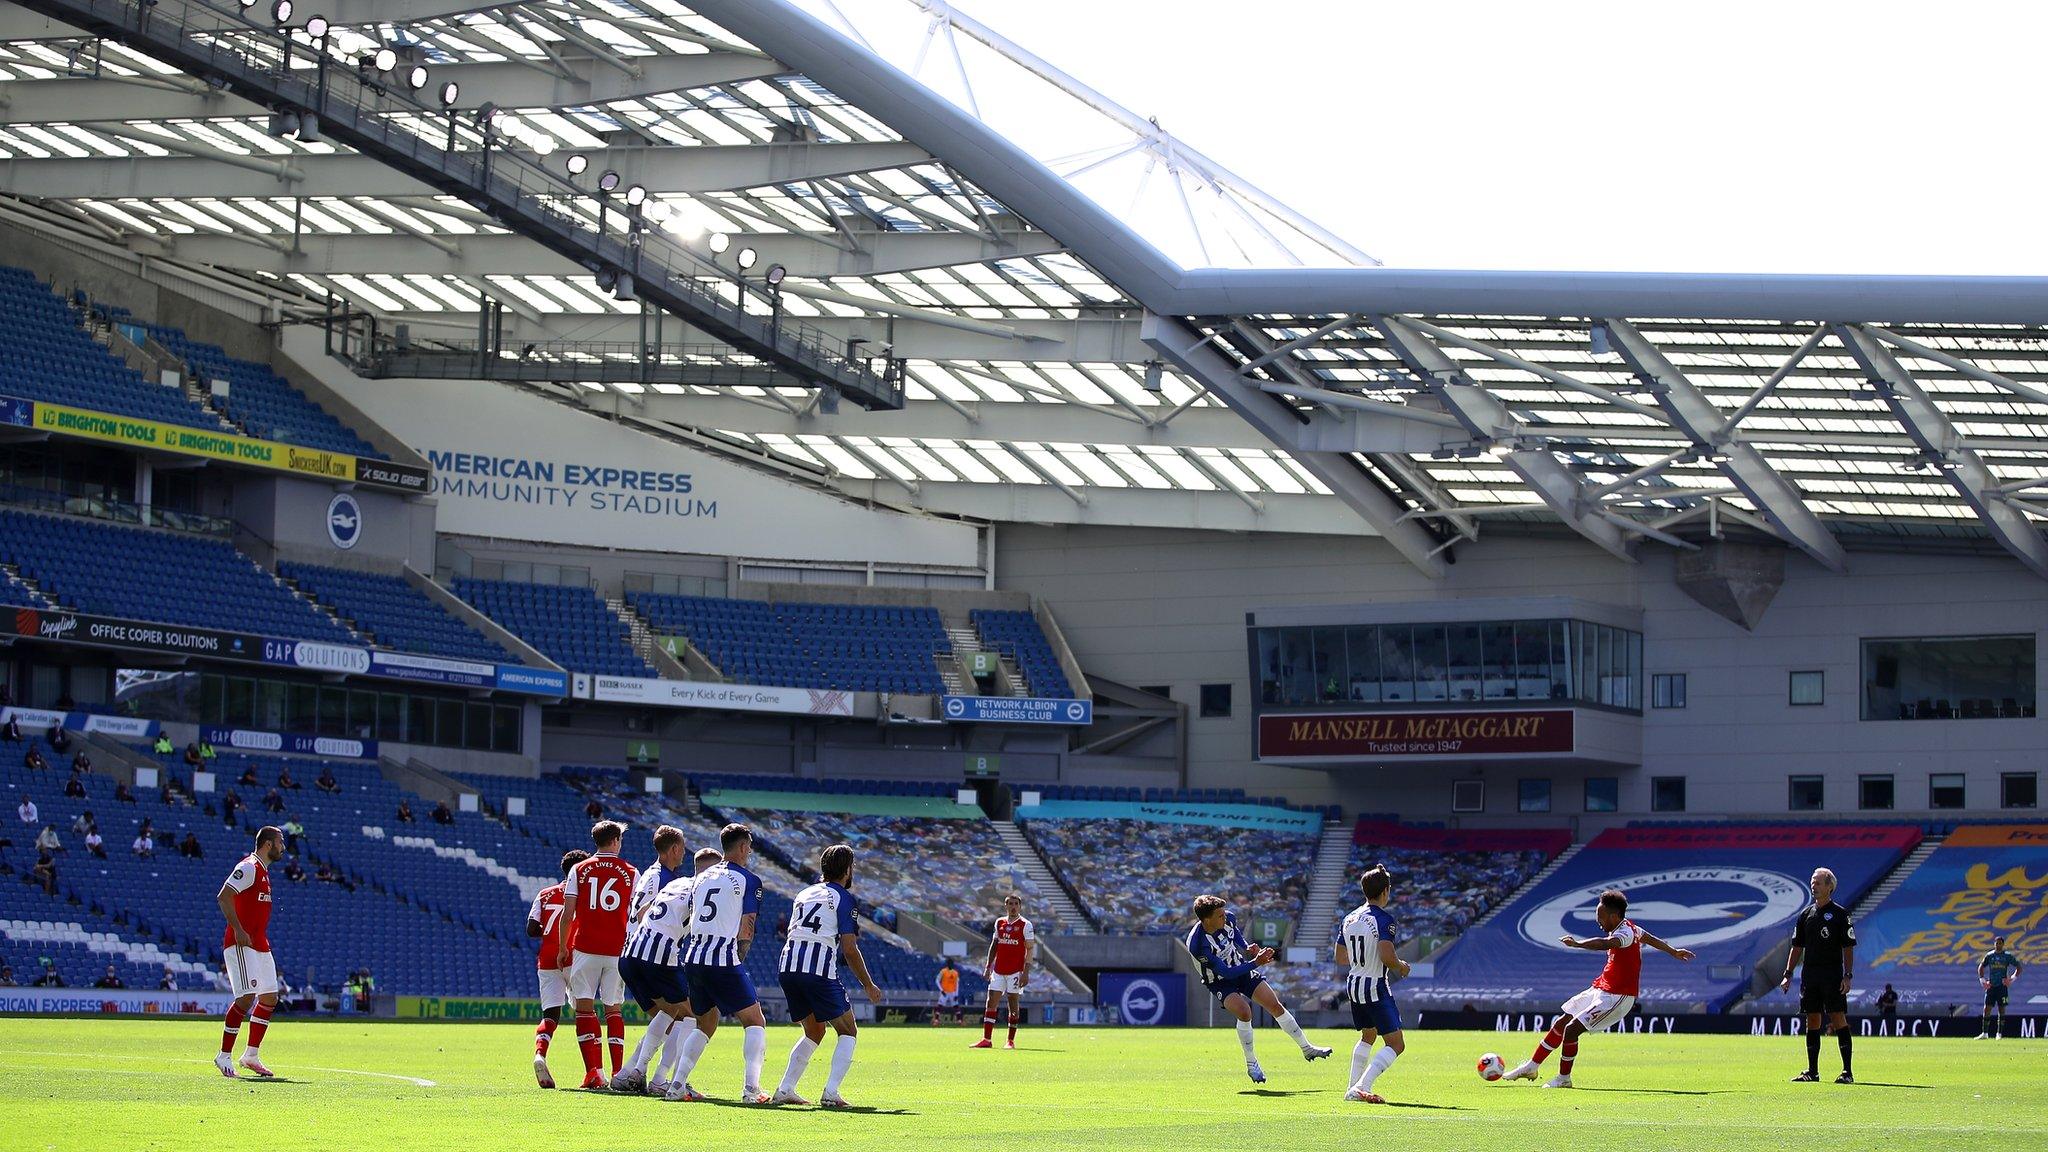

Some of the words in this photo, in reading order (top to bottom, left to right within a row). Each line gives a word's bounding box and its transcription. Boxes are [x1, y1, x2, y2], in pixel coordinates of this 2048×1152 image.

[58, 412, 116, 436] BRIGHTON
[120, 423, 156, 442] TOOLS
[180, 433, 235, 455] BRIGHTON
[238, 442, 272, 461] TOOLS
[415, 449, 553, 482] MERICAN
[564, 465, 692, 493] EXPRESS
[590, 492, 717, 518] STADIUM
[90, 624, 125, 640] OFFICE
[128, 628, 162, 645] COPIER
[165, 632, 218, 650] SOLUTIONS
[666, 638, 677, 654] A
[266, 642, 291, 661] GAP
[300, 646, 364, 669] SOLUTIONS
[975, 655, 986, 669] B
[501, 674, 534, 685] AMERICAN
[535, 676, 563, 687] EXPRESS
[599, 680, 619, 689] BBC
[671, 687, 694, 701] Every
[697, 689, 716, 700] Kick
[718, 691, 727, 700] of
[729, 691, 752, 703] Every
[755, 693, 779, 704] Game
[975, 700, 1021, 709] NETWORK
[1023, 701, 1057, 710] ALBION
[979, 710, 1026, 719] BUSINESS
[1028, 710, 1053, 719] CLUB
[1289, 719, 1398, 741] MANSELL
[1404, 716, 1544, 739] McTAGGART
[211, 731, 229, 743] GAP
[233, 733, 279, 748] SOLUTIONS
[295, 738, 313, 750] GAP
[316, 739, 361, 755] SOLUTIONS
[1367, 741, 1407, 753] Trusted
[1409, 741, 1435, 752] since
[1437, 740, 1462, 751] 1947
[639, 744, 647, 756] A
[977, 757, 987, 769] B
[1140, 806, 1169, 816] WE
[1172, 810, 1208, 818] ARE
[1212, 813, 1252, 822] ONE
[1256, 816, 1308, 826] TEAM
[615, 865, 631, 887] MATTER
[1587, 871, 1720, 896] BRIGHTON
[1753, 875, 1793, 896] HOVE
[588, 876, 620, 911] 16
[698, 887, 721, 923] 5
[542, 903, 565, 936] 7
[1264, 922, 1277, 939] B
[1350, 935, 1366, 967] 11
[444, 1001, 520, 1018] BRIGHTON
[1605, 1014, 1676, 1034] ARCY
[1751, 1017, 1800, 1035] MAR
[1861, 1018, 1940, 1037] DARCY
